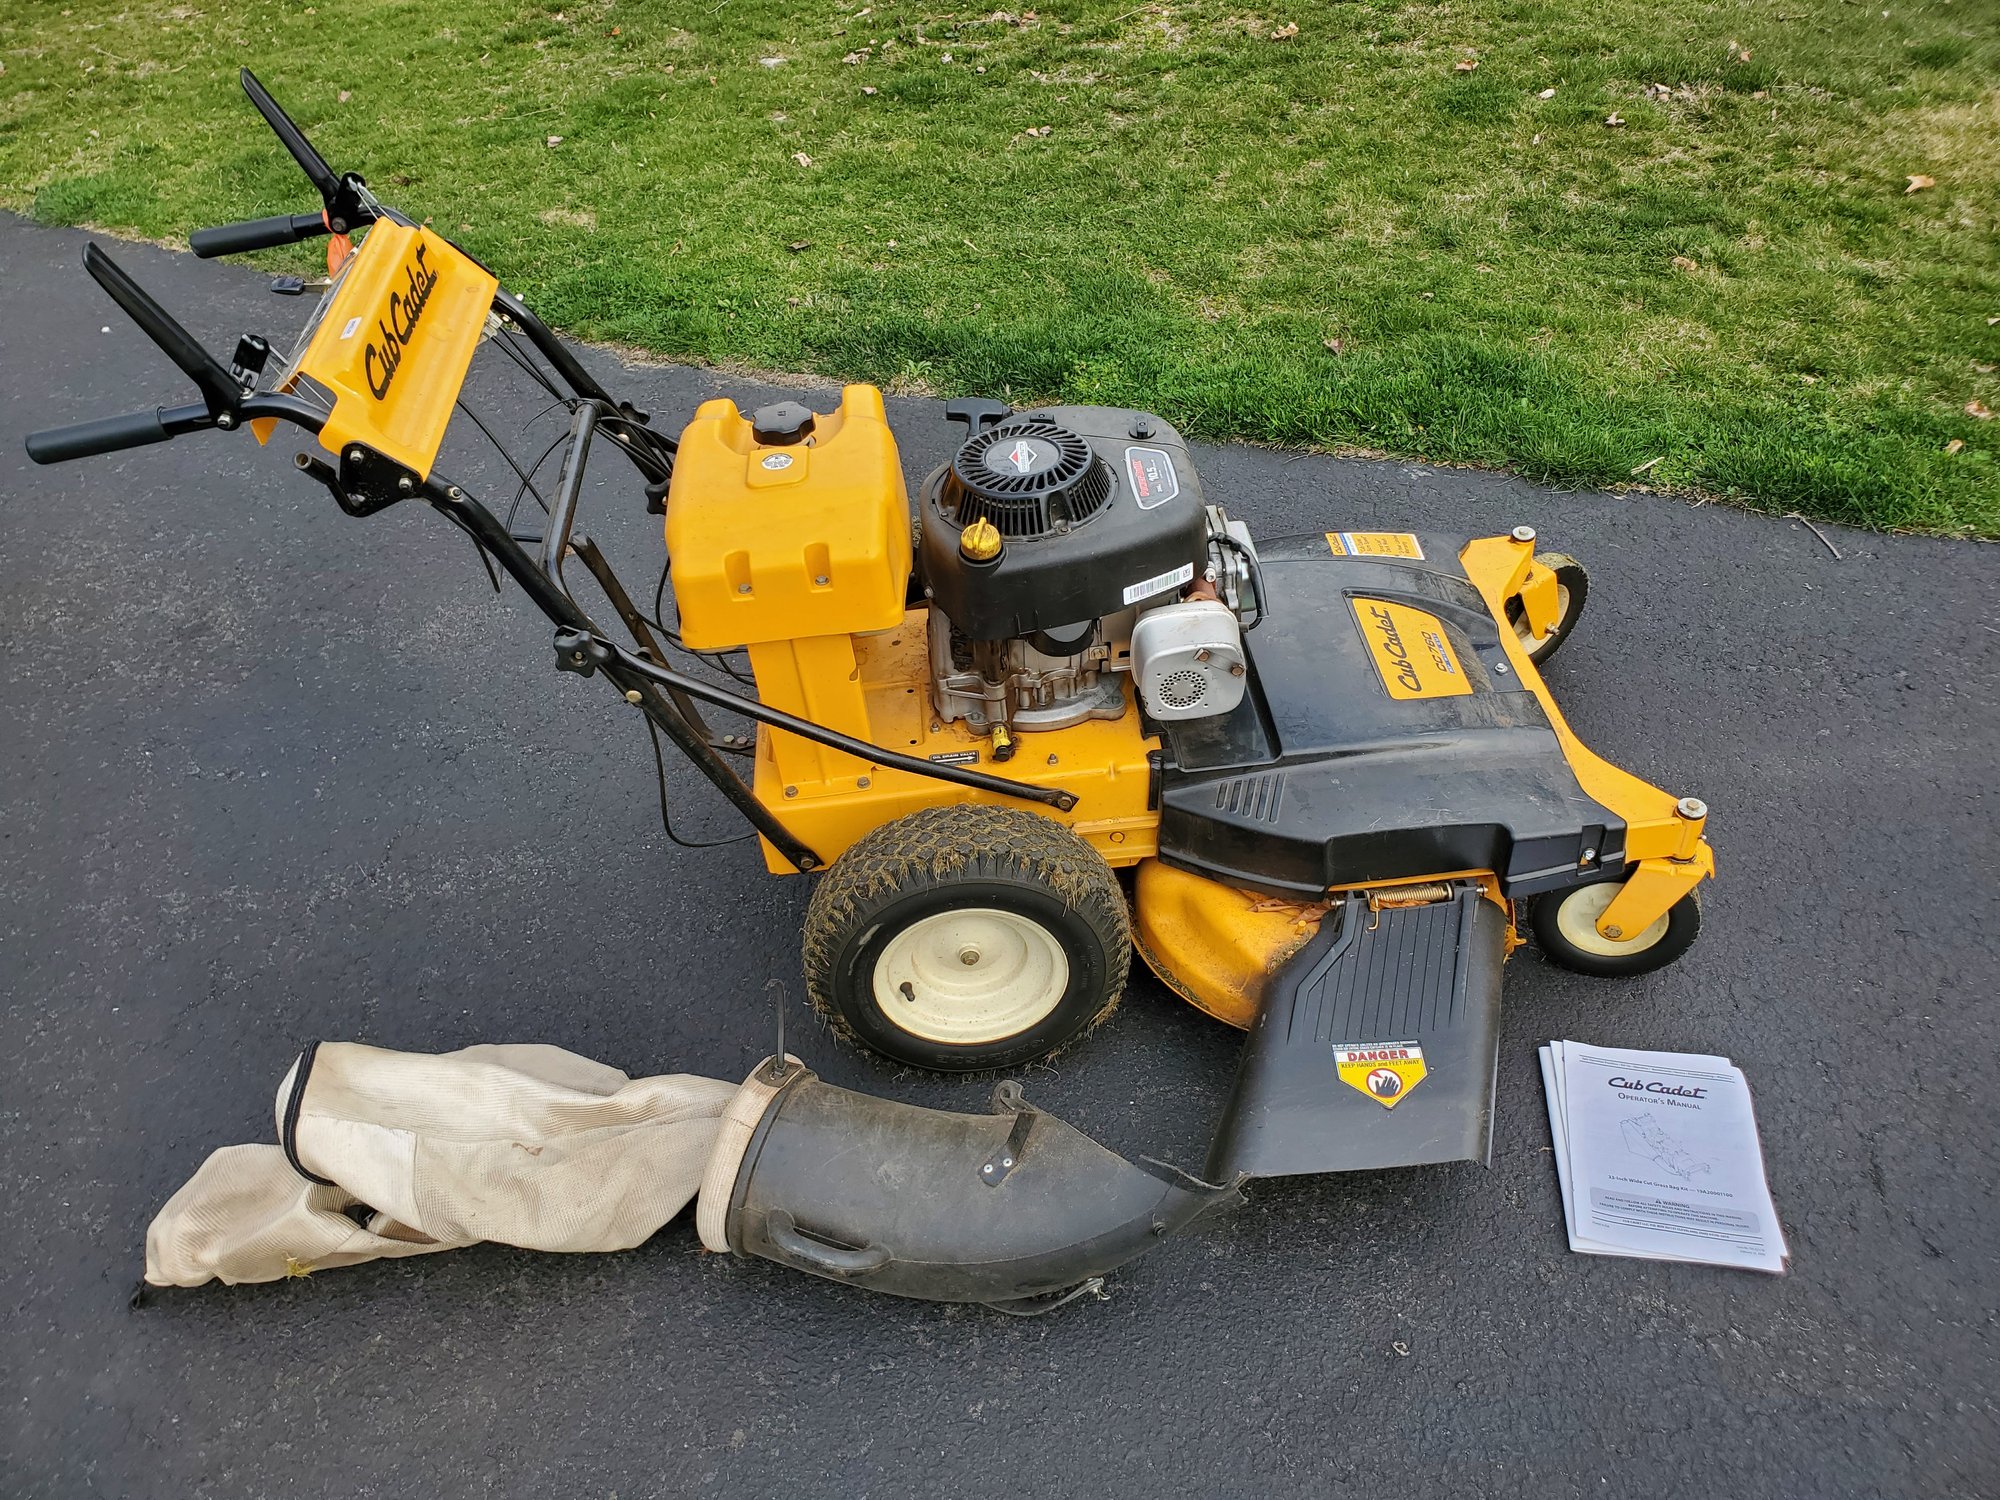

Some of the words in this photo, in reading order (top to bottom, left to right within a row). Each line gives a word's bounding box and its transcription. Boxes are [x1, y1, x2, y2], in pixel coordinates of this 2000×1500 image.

[365, 319, 401, 401] Cub
[390, 242, 438, 346] Cadet
[1146, 467, 1159, 482] 10.5
[1370, 606, 1407, 659] Cadet
[1421, 631, 1439, 654] 760
[1432, 655, 1447, 672] CC
[1391, 659, 1422, 692] Cub
[1347, 1049, 1409, 1062] DANGER
[1608, 1077, 1644, 1091] Cub
[1645, 1082, 1708, 1099] Cadet
[1667, 1098, 1702, 1110] MANUAL
[1662, 1201, 1690, 1209] WARNING
